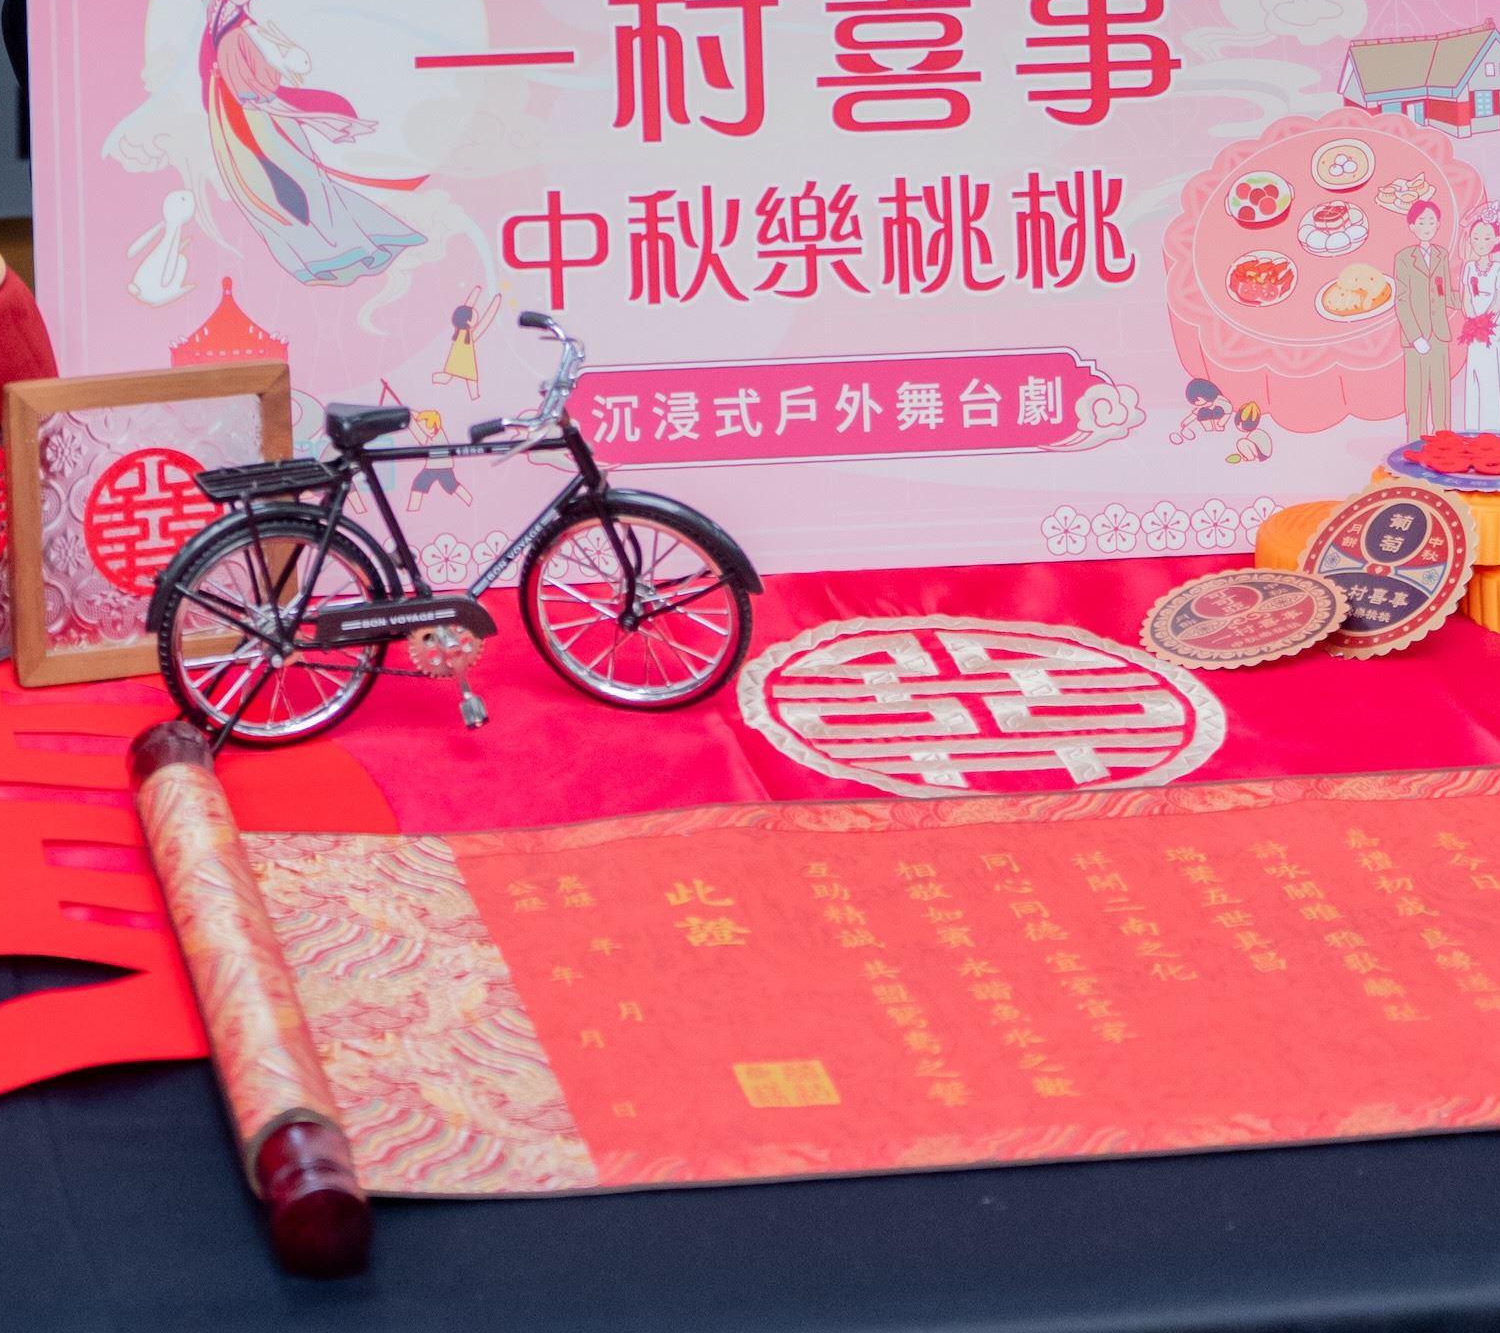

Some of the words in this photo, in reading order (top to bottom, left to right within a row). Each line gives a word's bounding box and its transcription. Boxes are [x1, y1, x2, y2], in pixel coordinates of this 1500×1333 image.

[502, 168, 1136, 311] 中秋樂桃桃
[592, 376, 1064, 443] 沉浸式戶外舞台劇
[486, 562, 507, 583] BON
[506, 523, 544, 565] VOYAGE
[1379, 513, 1414, 554] 葡萄
[1421, 535, 1444, 563] 中秋
[361, 618, 387, 629] BON
[389, 612, 435, 626] VOYAGE
